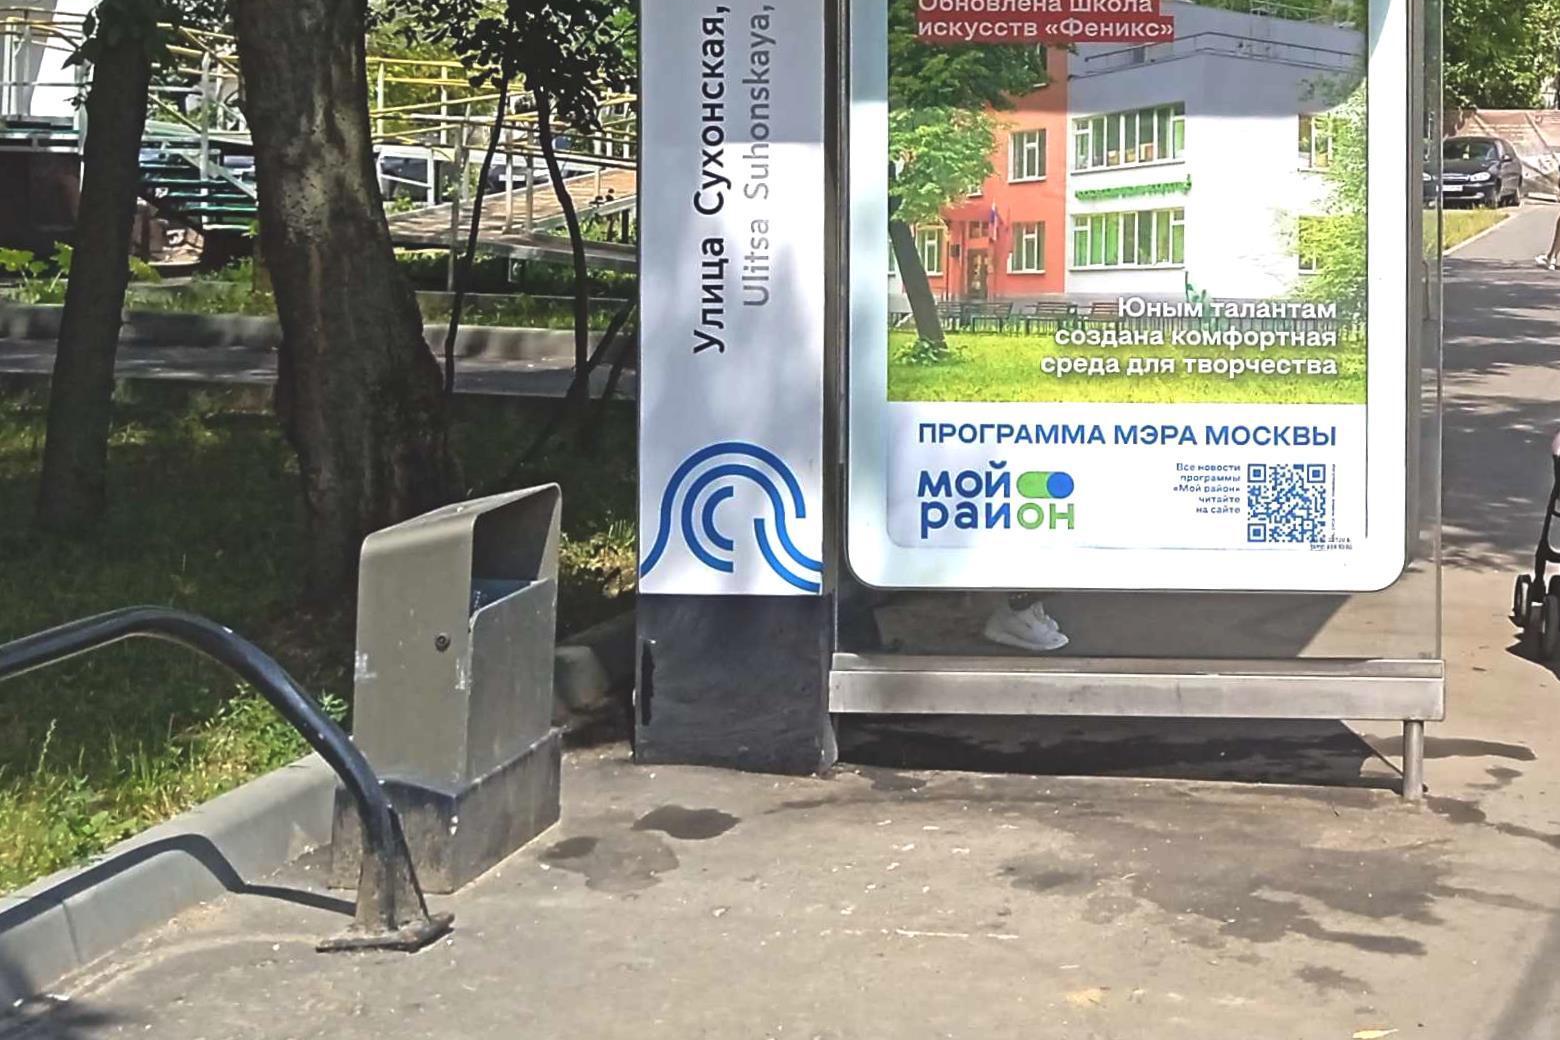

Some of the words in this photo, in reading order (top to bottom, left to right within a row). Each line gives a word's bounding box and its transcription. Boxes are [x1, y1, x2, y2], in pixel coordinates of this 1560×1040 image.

[917, 19, 1038, 39] искусств
[1045, 17, 1174, 38] «Феникс»
[693, 4, 731, 216] Сухонская,
[742, 3, 777, 201] Suhonskaya,
[742, 218, 770, 308] Ulitsa
[693, 237, 731, 355] Улица
[1117, 296, 1203, 319] Юным
[1210, 299, 1338, 319] талантам
[1054, 328, 1165, 350] создана
[1171, 326, 1338, 351] комфортная
[1040, 356, 1121, 379] среда
[1126, 356, 1176, 377] для
[1184, 356, 1338, 378] творчества
[917, 422, 1107, 446] ПРОГРАММА
[1113, 424, 1199, 447] МЭРА
[1205, 424, 1337, 447] МОСКВЫ
[917, 460, 1011, 498] мой
[1176, 462, 1195, 471] Все
[1197, 464, 1241, 472] новости
[1180, 475, 1241, 483] программы
[1198, 495, 1241, 503] читайте
[1210, 505, 1241, 514] сайте
